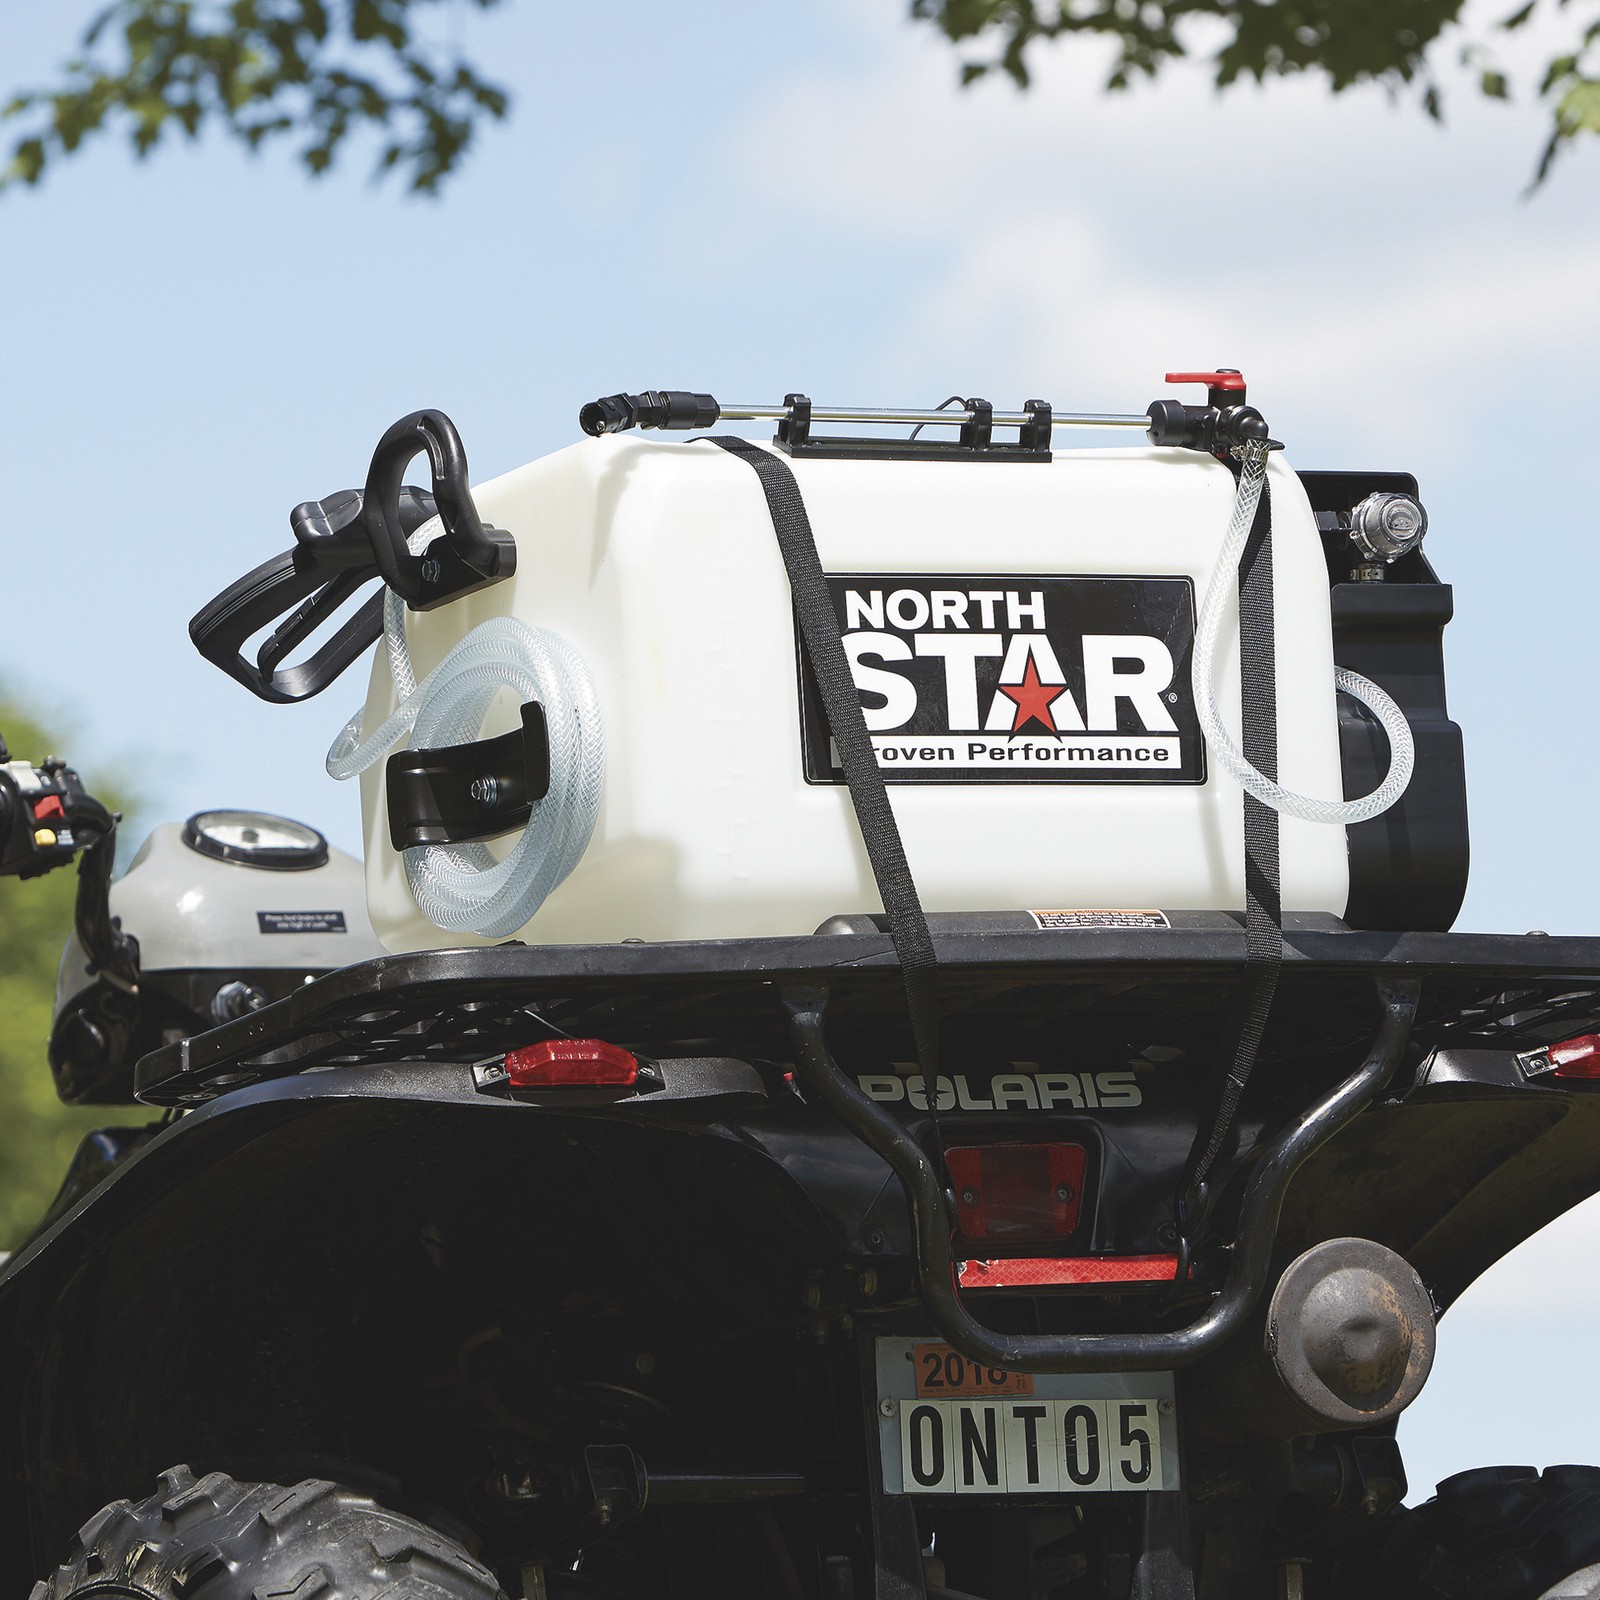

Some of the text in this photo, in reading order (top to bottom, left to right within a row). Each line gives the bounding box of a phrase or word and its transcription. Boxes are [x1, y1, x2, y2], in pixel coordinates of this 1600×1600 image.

[845, 589, 1046, 630] NORTH
[841, 631, 1180, 733] STAR
[873, 743, 1169, 762] oven Performance
[857, 1071, 1143, 1111] POLARIS
